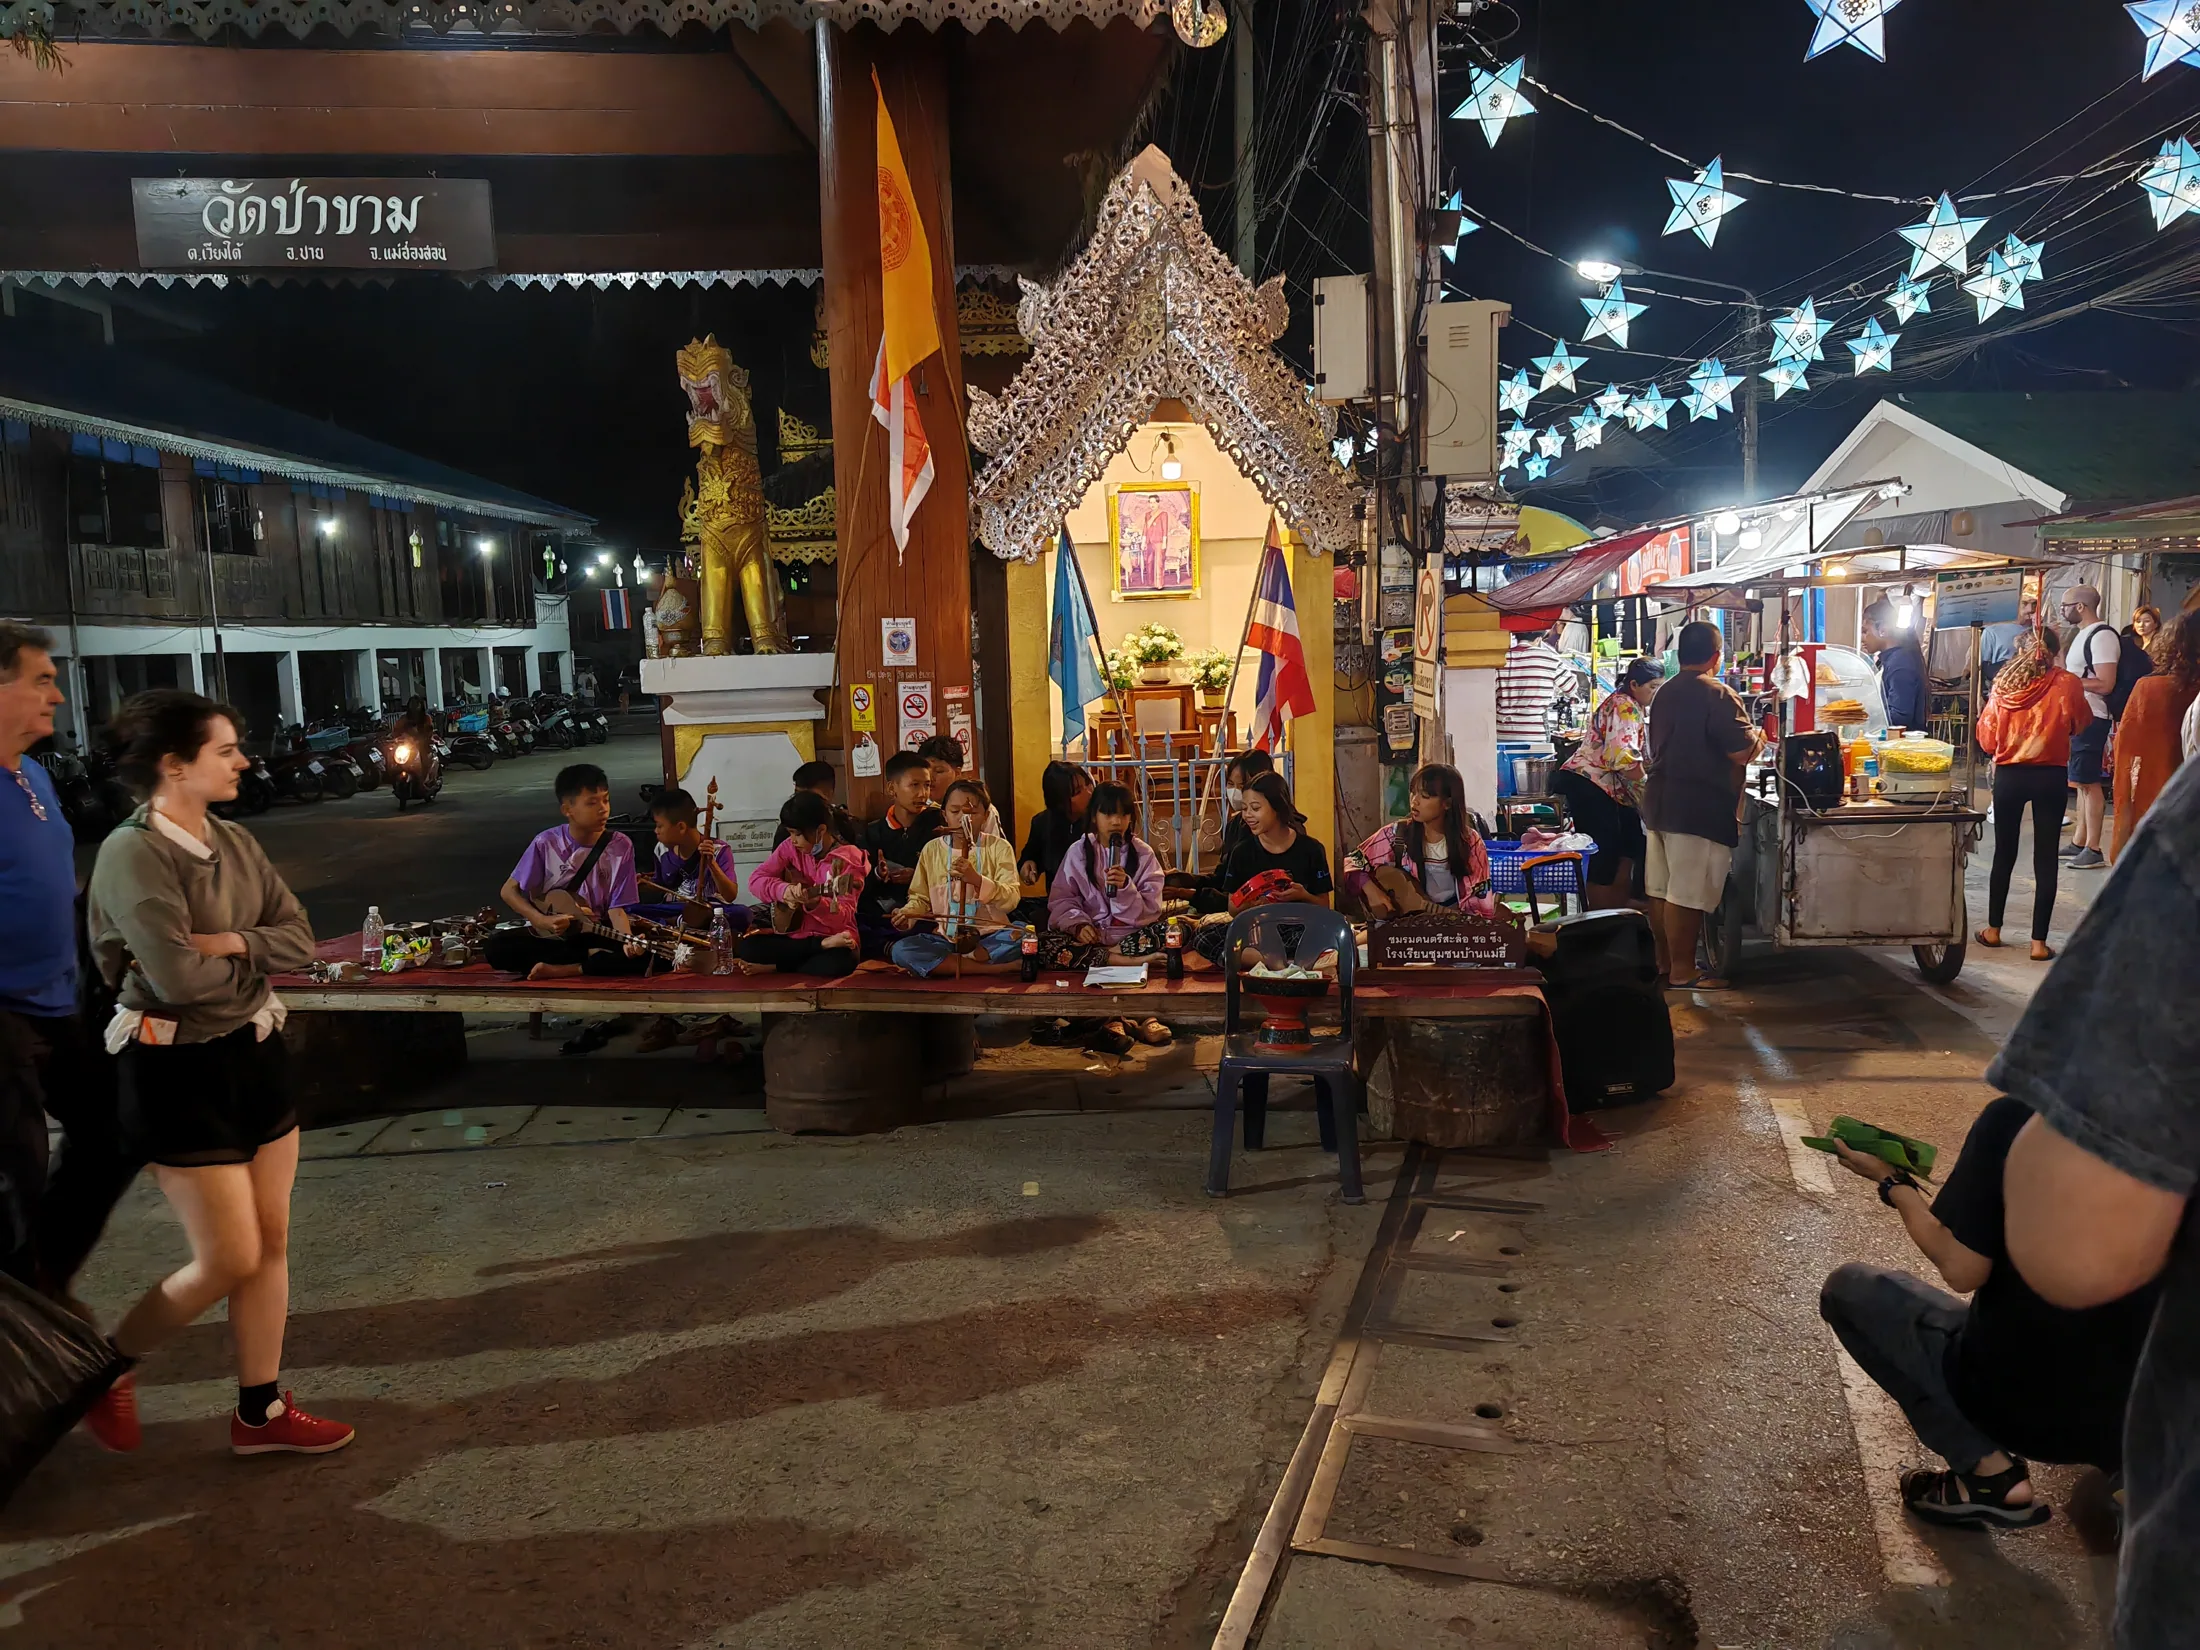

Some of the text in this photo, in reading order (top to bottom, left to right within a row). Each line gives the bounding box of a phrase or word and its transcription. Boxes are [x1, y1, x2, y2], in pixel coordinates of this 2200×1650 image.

[202, 178, 424, 238] วัดป่าขาม
[187, 241, 447, 261] ต.เวียงใต้ อ.ปาย จ.แม่ฮ่องสอน
[1388, 933, 1469, 945] ชมรมดนตรีสะล้อ
[1472, 936, 1486, 944] ซอ
